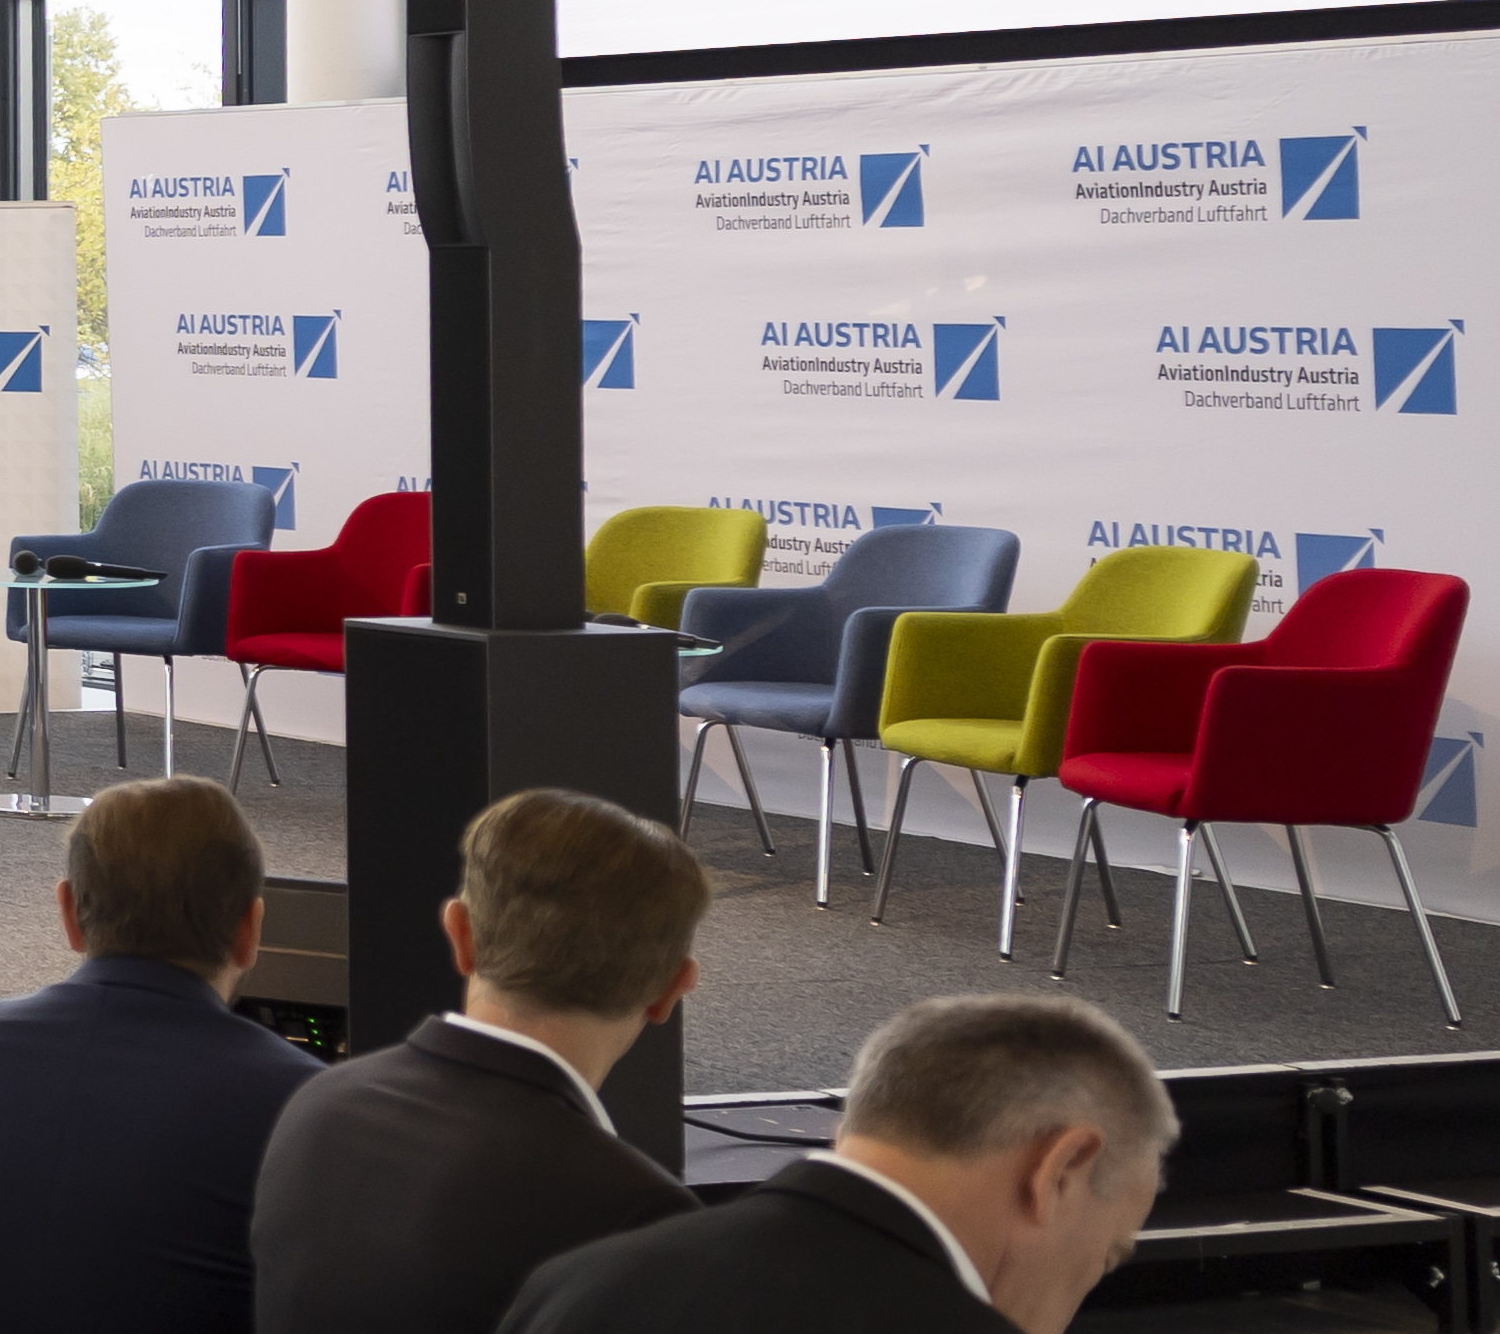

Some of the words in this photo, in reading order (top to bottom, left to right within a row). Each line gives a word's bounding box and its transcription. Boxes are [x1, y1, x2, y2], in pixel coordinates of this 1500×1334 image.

[1073, 146, 1104, 172] AI
[1113, 140, 1265, 171] AUSTRIA
[695, 160, 720, 184] AI
[727, 156, 848, 182] AUSTRIA
[130, 179, 147, 198] AI
[152, 177, 235, 198] AUSTRIA
[387, 172, 407, 192] AI
[1076, 181, 1204, 200] AviationIndustry
[1209, 178, 1266, 195] Austria
[696, 192, 799, 210] AviationIndustry
[803, 190, 849, 205] Austria
[131, 206, 201, 221] AviationIndustry
[204, 206, 235, 217] Austria
[717, 215, 792, 230] Dachverband
[795, 214, 851, 229] Luftfahrt
[1101, 206, 1193, 224] Dachverband
[1198, 205, 1267, 222] Luftfahrt
[145, 225, 196, 237] Dachverband
[199, 224, 236, 237] Luftfahrt
[177, 314, 194, 333] AI
[200, 315, 285, 335] AUSTRIA
[762, 322, 787, 346] AI
[795, 323, 921, 348] AUSTRIA
[1156, 326, 1189, 352] AI
[1198, 327, 1357, 355] AUSTRIA
[178, 342, 250, 359] AviationIndustry
[253, 344, 286, 357] Austria
[192, 362, 245, 375] Dachverband
[247, 364, 286, 377] Luftfahrt
[763, 356, 869, 377] AviationIndustry
[874, 358, 922, 374] Austria
[1158, 364, 1293, 387] AviationIndustry
[1298, 367, 1358, 384] Austria
[784, 380, 861, 396] Dachverband
[865, 382, 923, 398] Luftfahrt
[1185, 391, 1282, 409] Dachverband
[1287, 393, 1360, 411] Luftfahrt
[140, 460, 157, 480] AI
[161, 462, 245, 483] AUSTRIA
[814, 538, 854, 554] Austr
[1087, 520, 1120, 548] AI
[1128, 523, 1282, 559] AUSTRIA
[763, 558, 803, 575] erband
